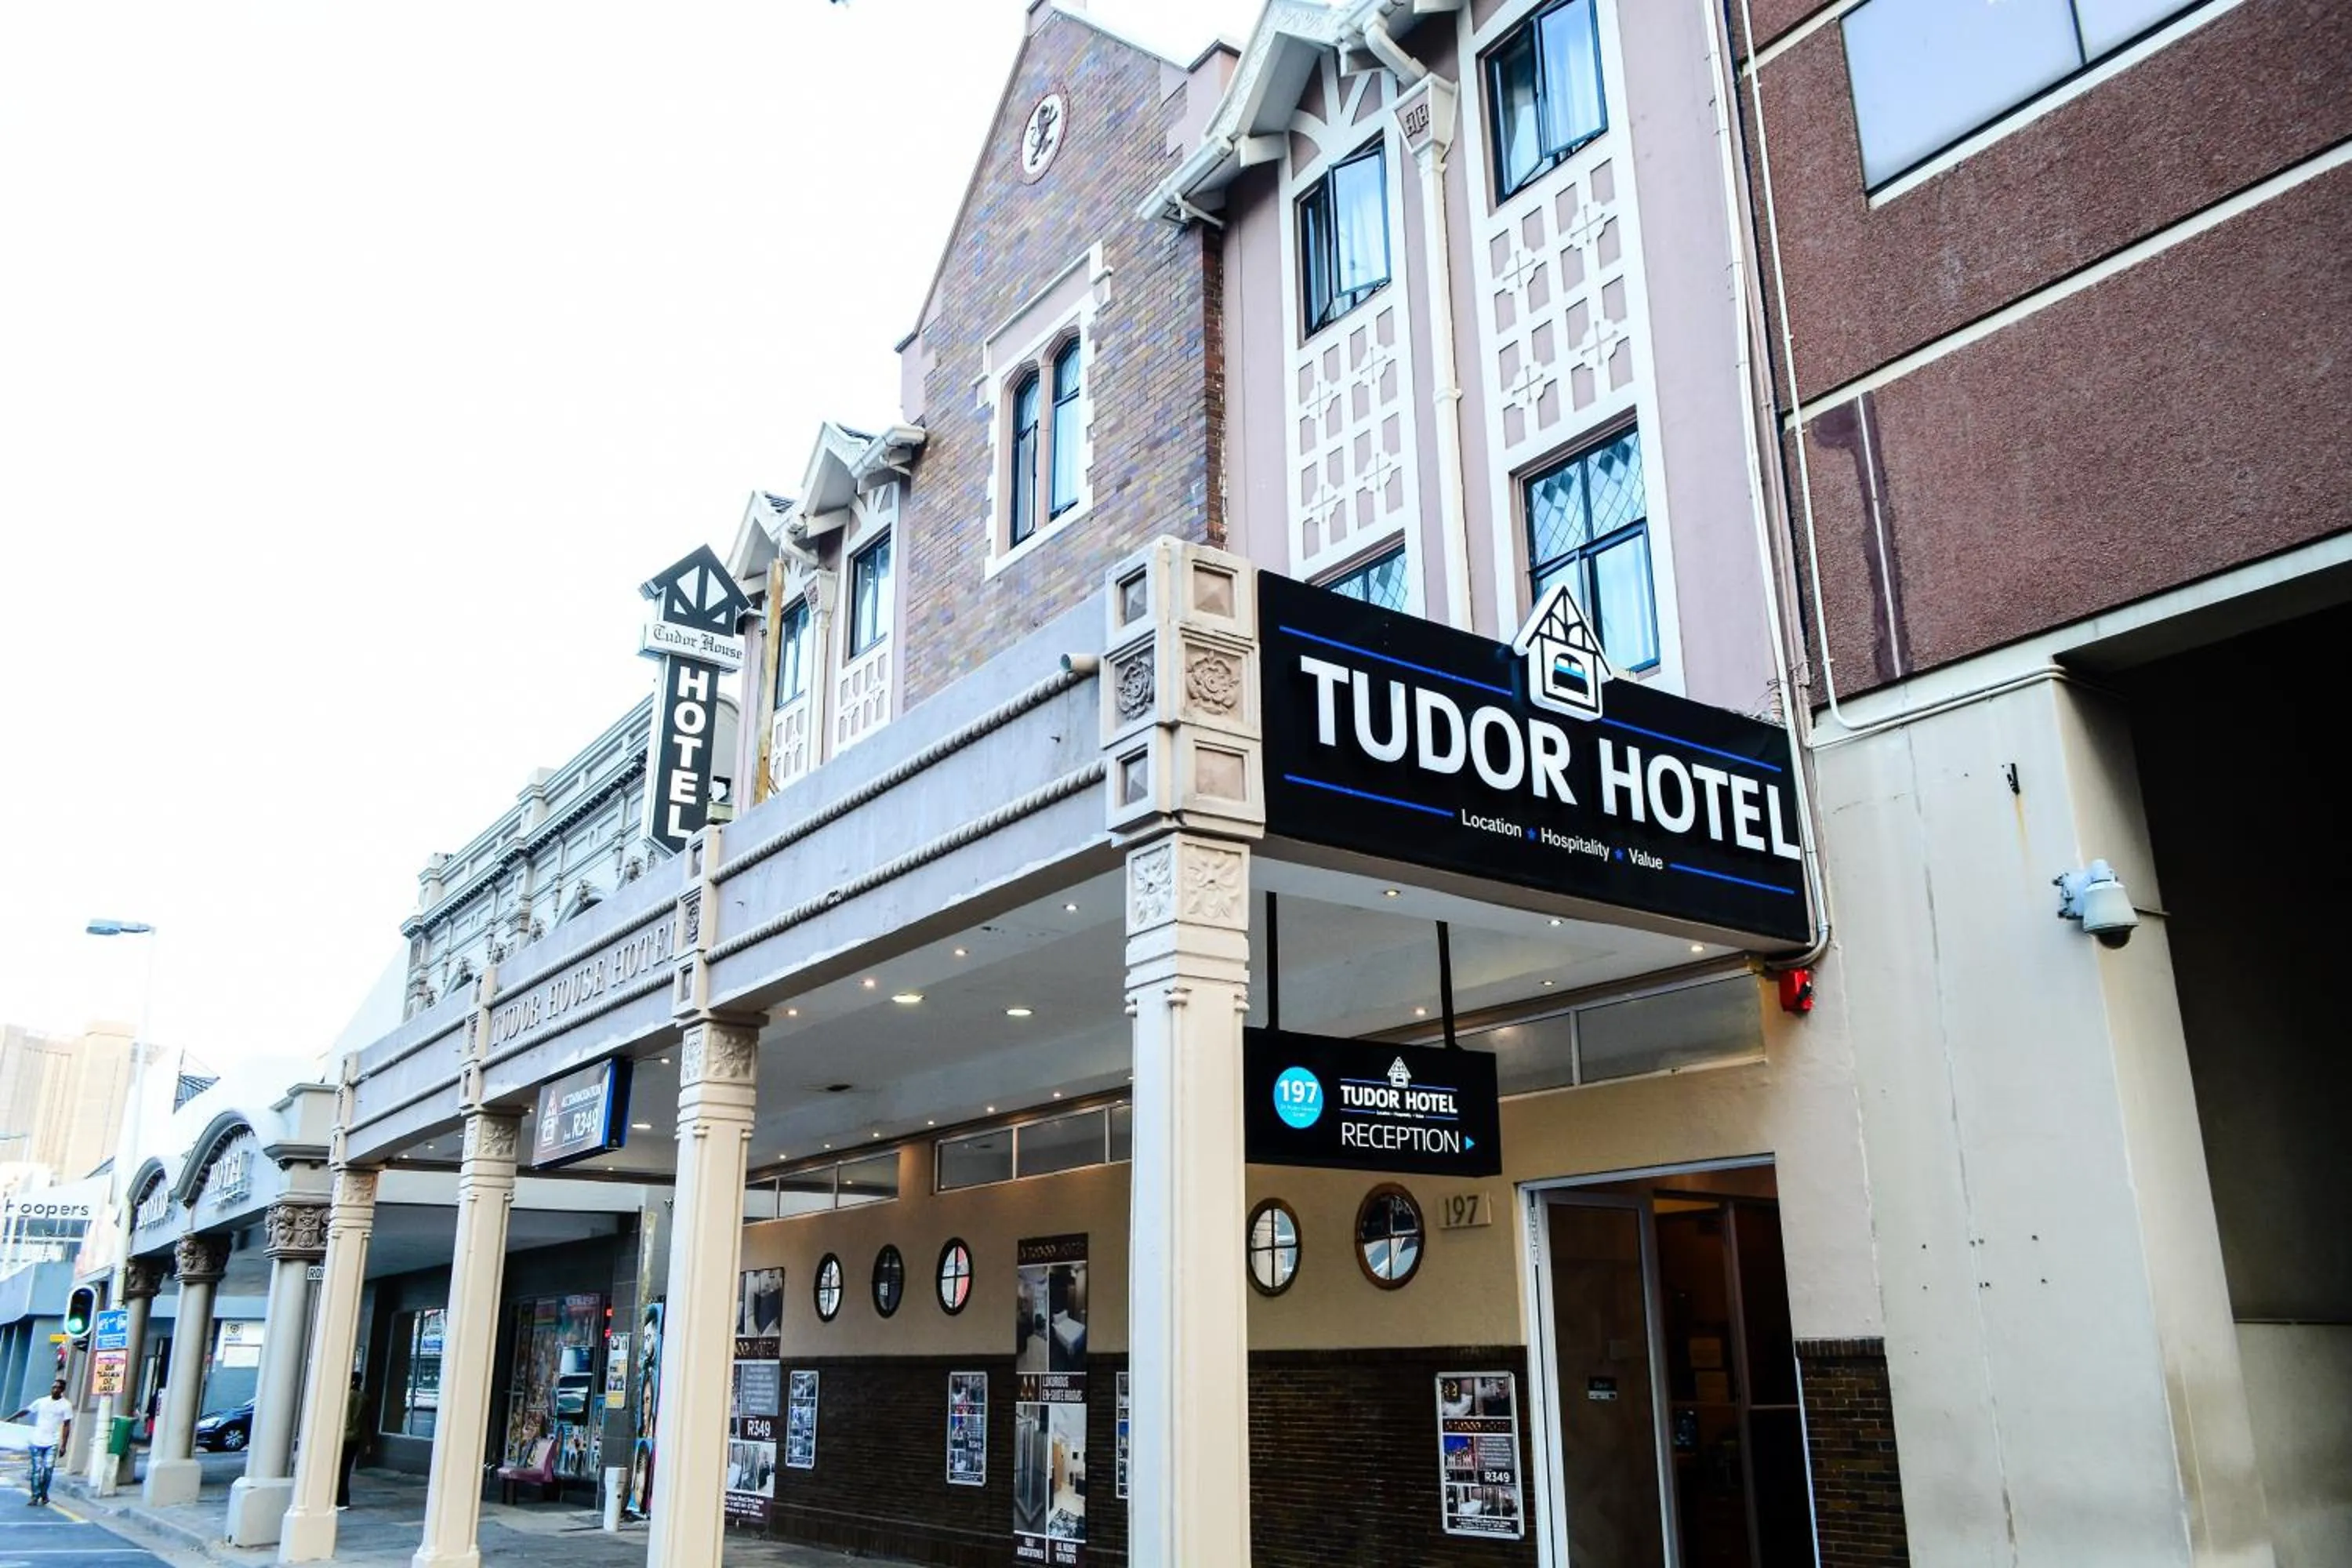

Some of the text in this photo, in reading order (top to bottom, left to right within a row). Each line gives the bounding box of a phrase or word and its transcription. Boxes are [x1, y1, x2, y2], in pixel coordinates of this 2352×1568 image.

[652, 625, 742, 661] Tudor House
[667, 666, 710, 839] HOTEL
[1300, 655, 1801, 861] TUDOR HOTEL
[1461, 808, 1664, 870] Location Hospitality Value
[491, 993, 541, 1047] TUDOR
[546, 959, 604, 1019] HOUSE
[1279, 1080, 1318, 1104] 197
[1340, 1085, 1400, 1110] TUDOR
[1405, 1091, 1458, 1114] HOTEL
[1341, 1122, 1460, 1154] RECEPTION
[1445, 1194, 1479, 1226] 197
[747, 1420, 771, 1438] R349
[1484, 1470, 1511, 1483] R349
